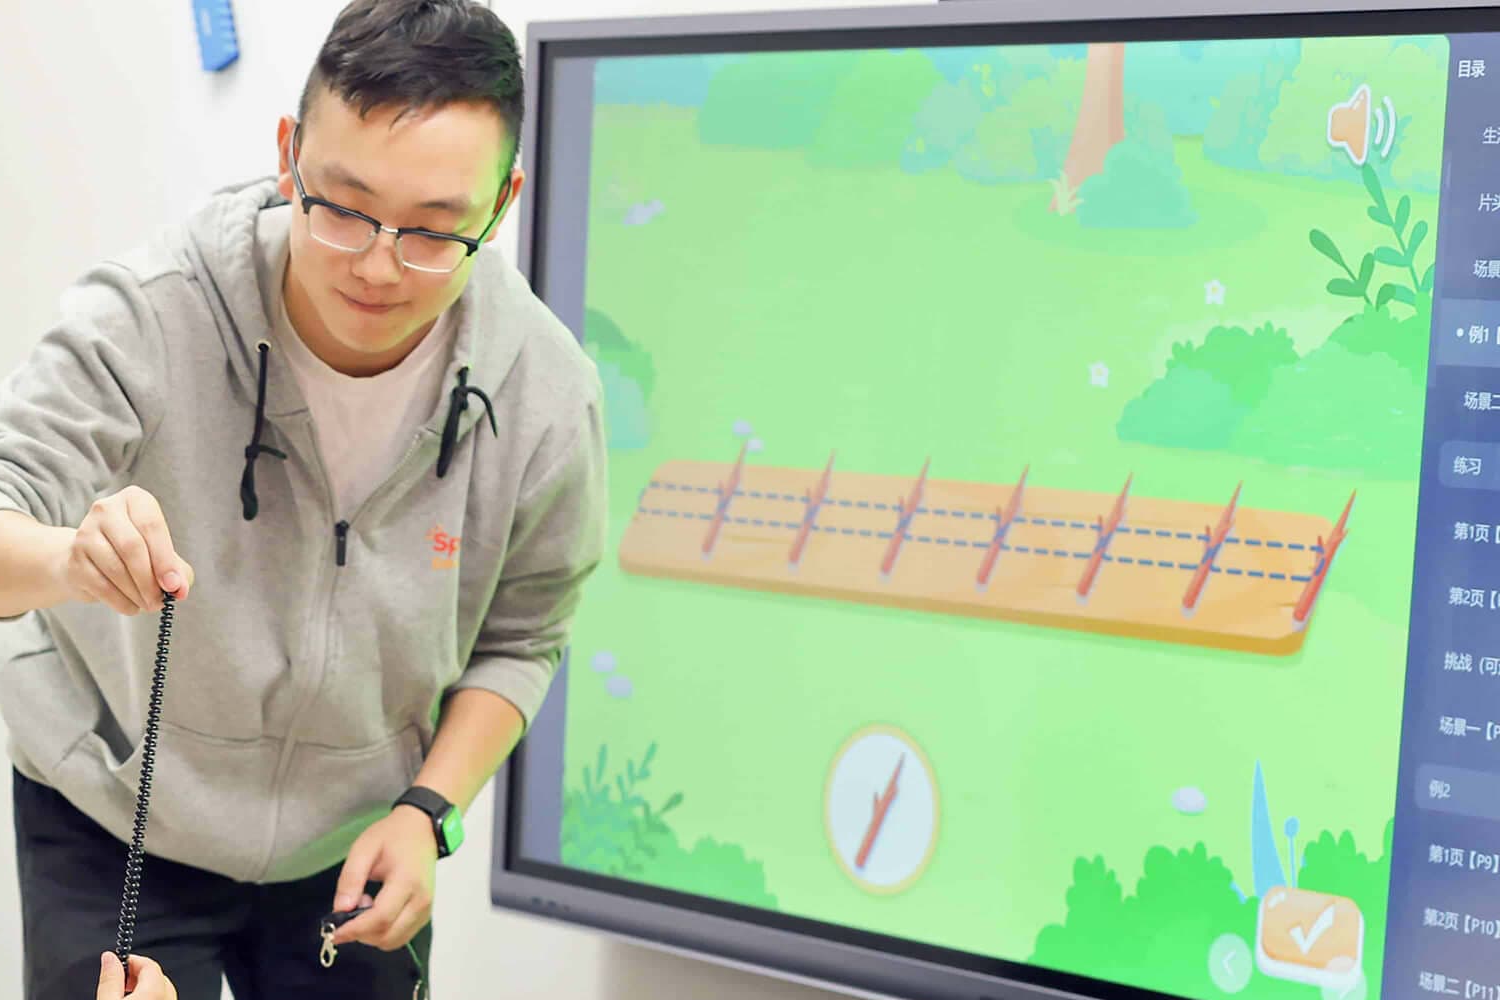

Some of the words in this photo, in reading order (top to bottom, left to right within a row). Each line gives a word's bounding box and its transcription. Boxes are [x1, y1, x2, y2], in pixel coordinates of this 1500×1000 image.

[1457, 59, 1486, 78] 目录
[1482, 126, 1500, 145] 生
[1453, 455, 1482, 476] 练习
[1428, 779, 1451, 799] 例2
